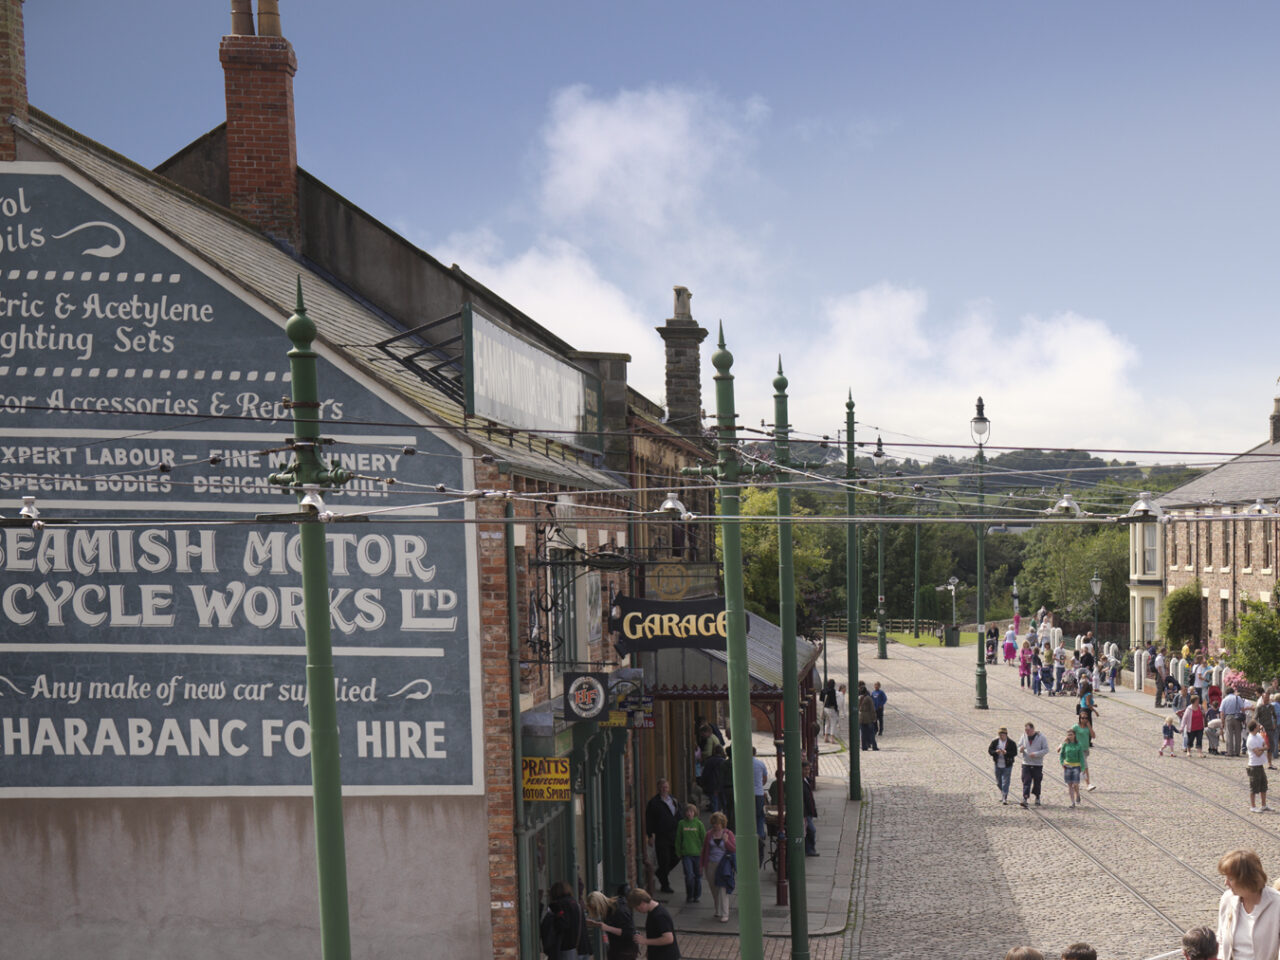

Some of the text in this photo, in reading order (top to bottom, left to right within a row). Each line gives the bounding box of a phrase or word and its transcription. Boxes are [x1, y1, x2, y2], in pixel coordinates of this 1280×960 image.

[55, 292, 76, 319] &
[82, 293, 214, 328] Acetylene
[114, 326, 175, 353] Sets
[46, 389, 199, 417] Accessories
[210, 391, 231, 417] &
[86, 447, 175, 467] LABOUR
[209, 449, 261, 468] FINE
[0, 473, 88, 492] SPECIAL
[95, 475, 172, 493] BODIES
[0, 527, 219, 577] EAMISH
[2, 580, 176, 628] CYCLE
[31, 674, 82, 705] Any
[88, 674, 150, 700] make
[156, 675, 184, 706] of
[184, 681, 226, 700] new
[233, 682, 273, 702] car
[262, 719, 343, 758] FO
[357, 720, 447, 759] HIRE
[526, 777, 569, 785] PERFECTION
